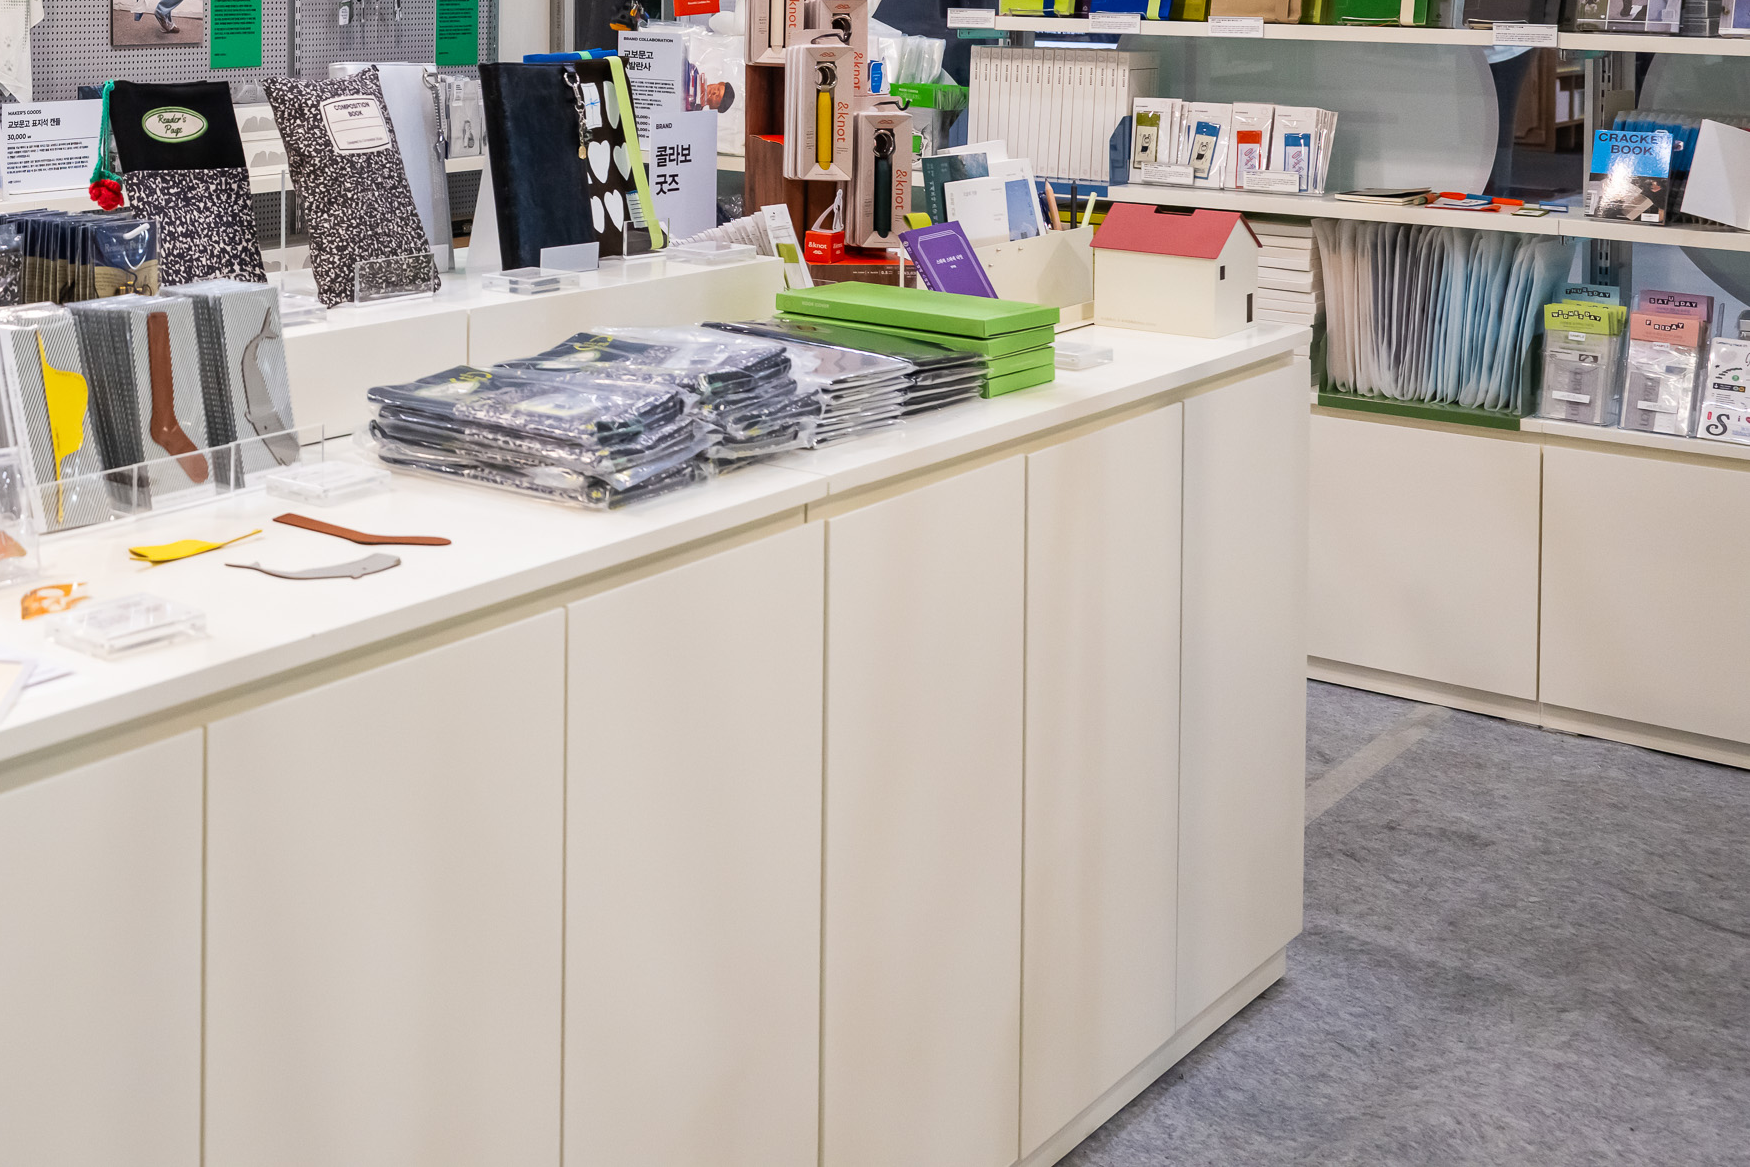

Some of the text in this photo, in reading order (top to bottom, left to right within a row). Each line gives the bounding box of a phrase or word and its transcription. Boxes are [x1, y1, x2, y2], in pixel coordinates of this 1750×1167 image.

[624, 50, 653, 59] 교보문고
[334, 102, 370, 110] COMPOSITION
[8, 120, 30, 128] 교보문고
[157, 114, 186, 124] Reader's
[837, 101, 849, 143] &knot
[165, 124, 182, 136] Page
[656, 144, 692, 167] 콜라보
[1610, 144, 1653, 156] BOOK
[655, 174, 679, 195] 굿즈
[895, 169, 907, 210] &knot
[1566, 287, 1610, 298] THURSDAY
[1649, 296, 1697, 307] SATURDAY
[1646, 320, 1684, 331] FRIDAY
